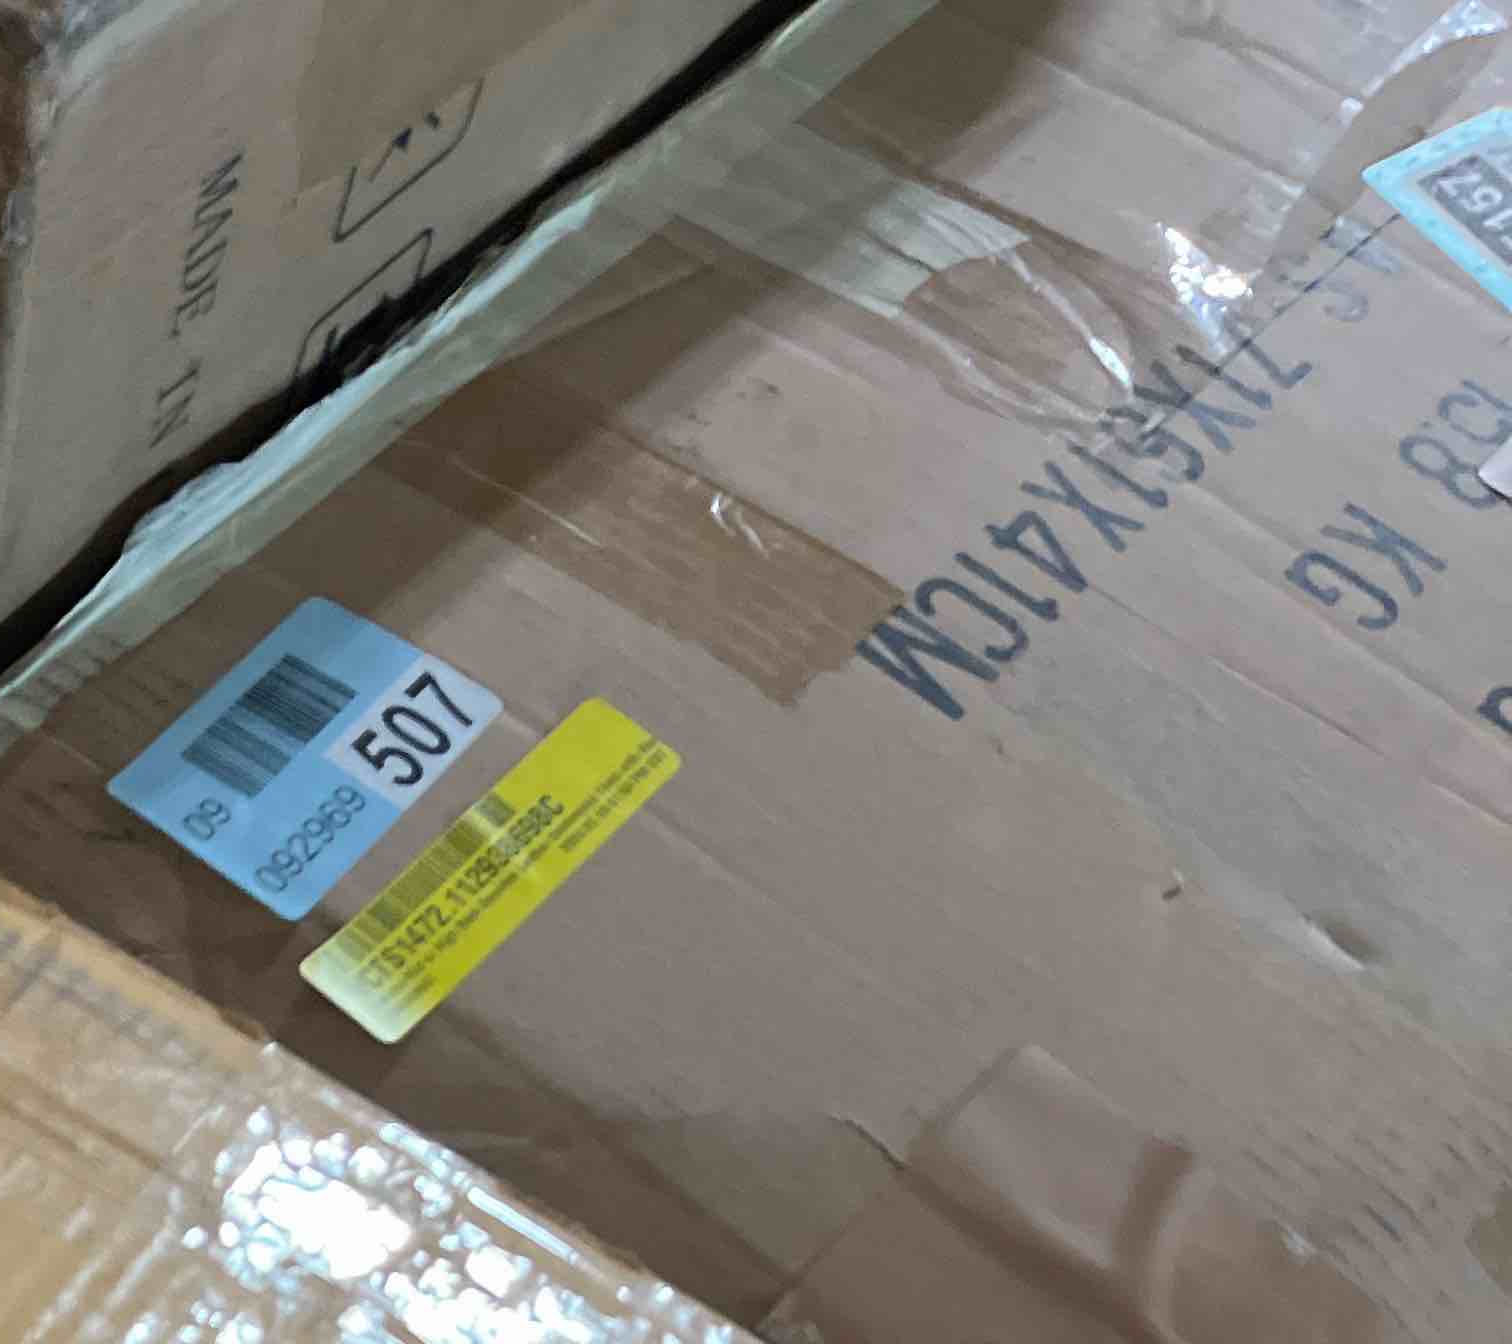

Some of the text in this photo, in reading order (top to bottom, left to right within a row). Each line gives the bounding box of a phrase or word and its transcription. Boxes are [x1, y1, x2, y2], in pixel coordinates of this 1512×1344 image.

[1285, 501, 1448, 630] KG
[351, 671, 473, 787] 507
[182, 796, 232, 842] 09
[254, 784, 367, 894] 092969
